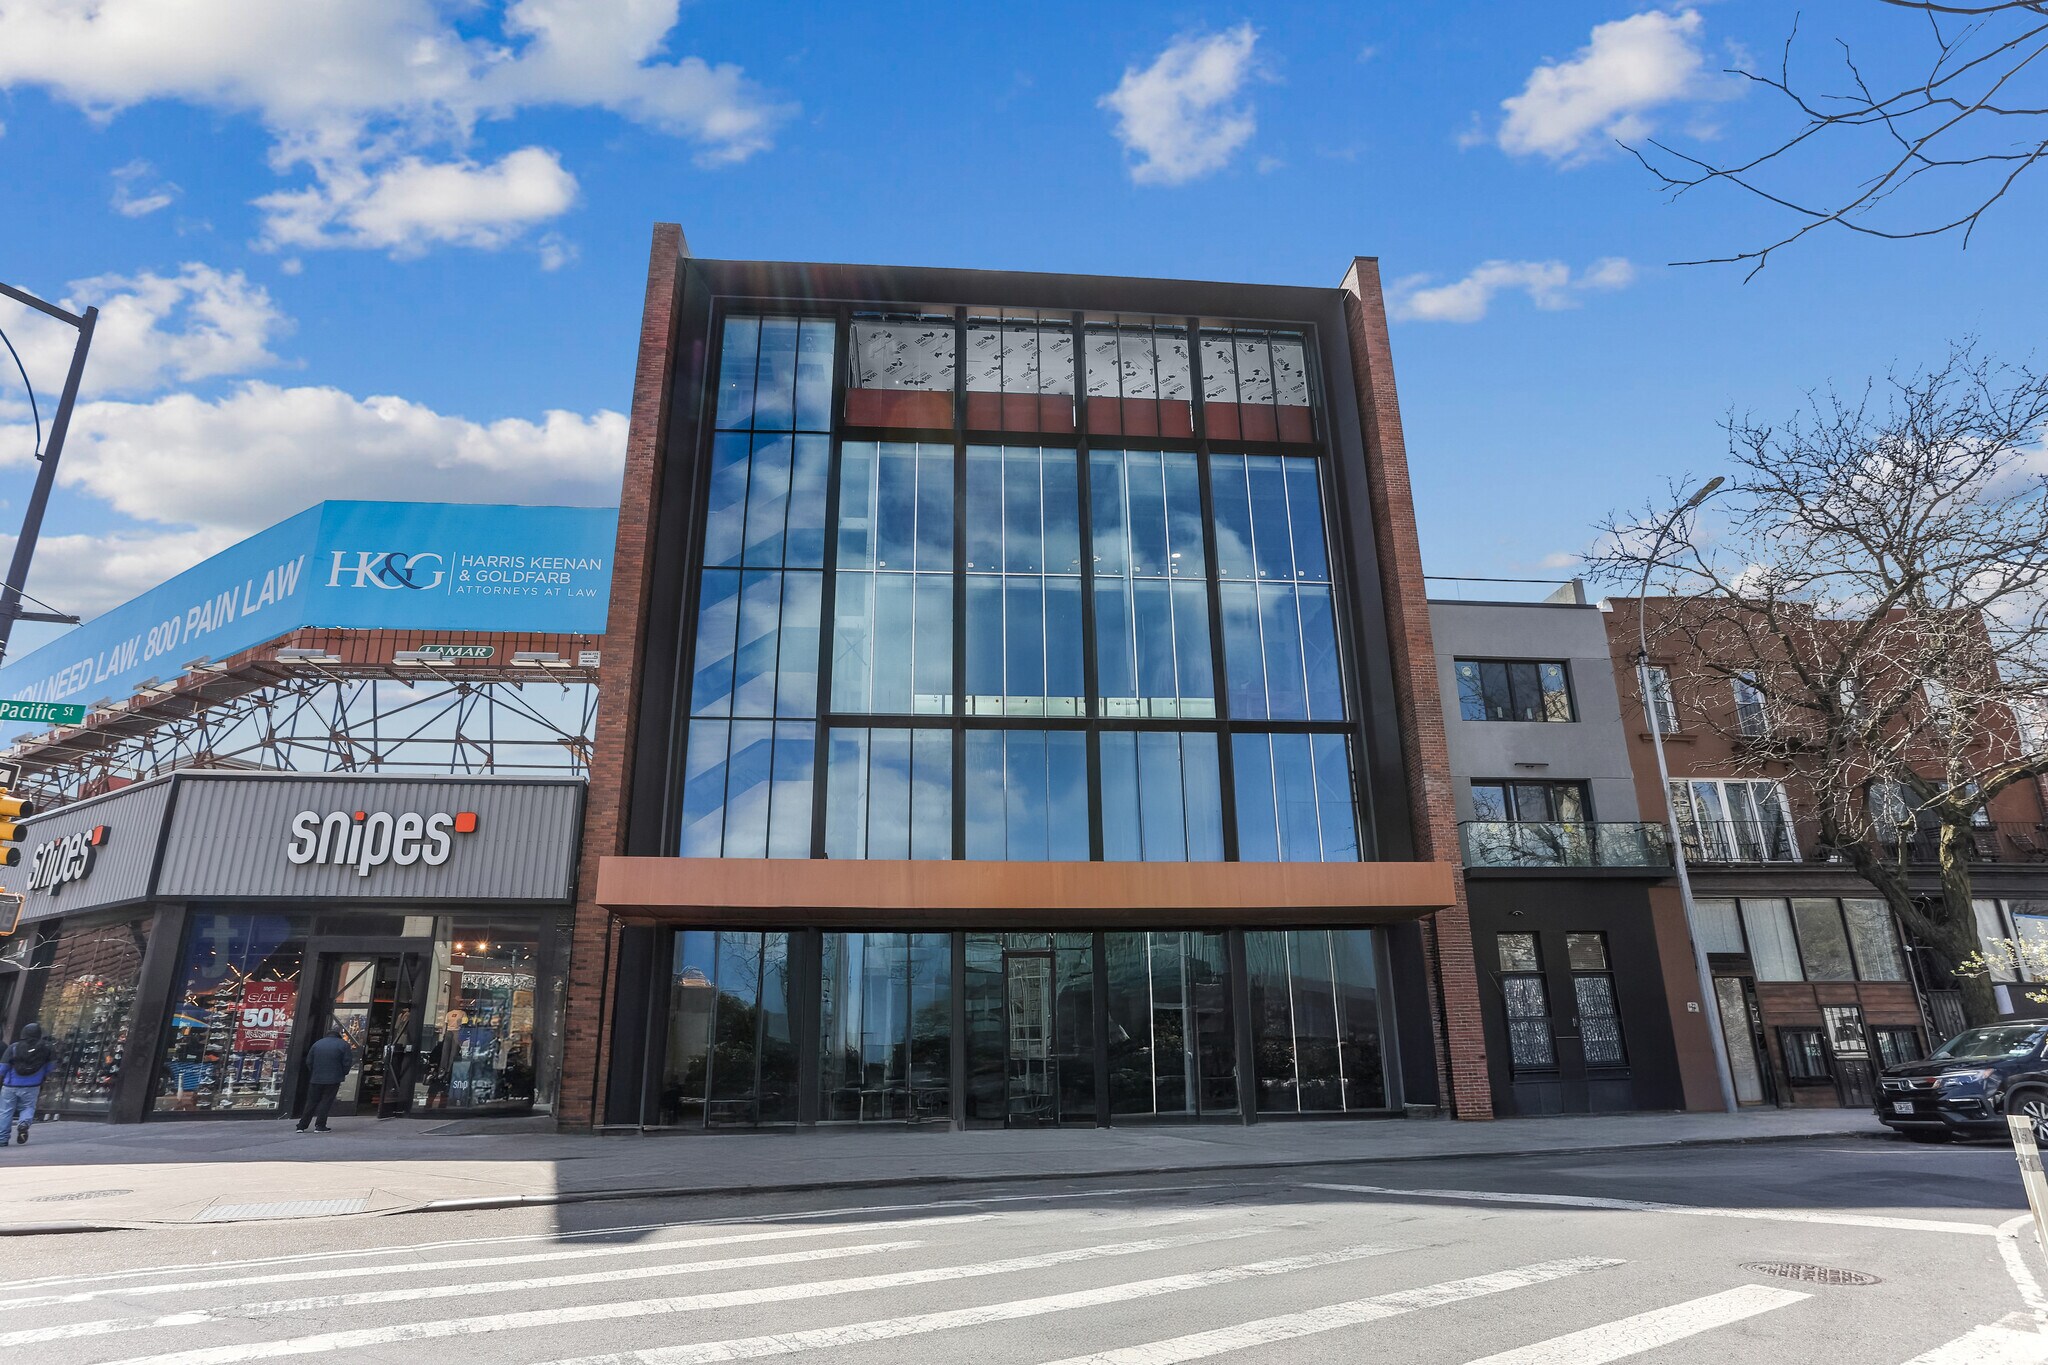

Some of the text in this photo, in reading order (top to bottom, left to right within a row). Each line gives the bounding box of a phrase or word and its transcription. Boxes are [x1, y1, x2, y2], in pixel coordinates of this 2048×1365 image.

[325, 551, 445, 590] HK&G
[461, 555, 602, 571] HARRIS KEENAN
[459, 569, 571, 584] & GOLDFARB
[456, 586, 598, 597] ATTORNEYS AT LAW
[45, 657, 94, 703] NEED
[94, 634, 142, 684] LAW.
[144, 616, 181, 663] 800
[183, 586, 240, 645] PAIN
[241, 554, 305, 617] LAW
[0, 703, 74, 720] Pacific St
[287, 810, 454, 877] snipes
[26, 829, 93, 896] snipes
[247, 992, 289, 1003] SALE
